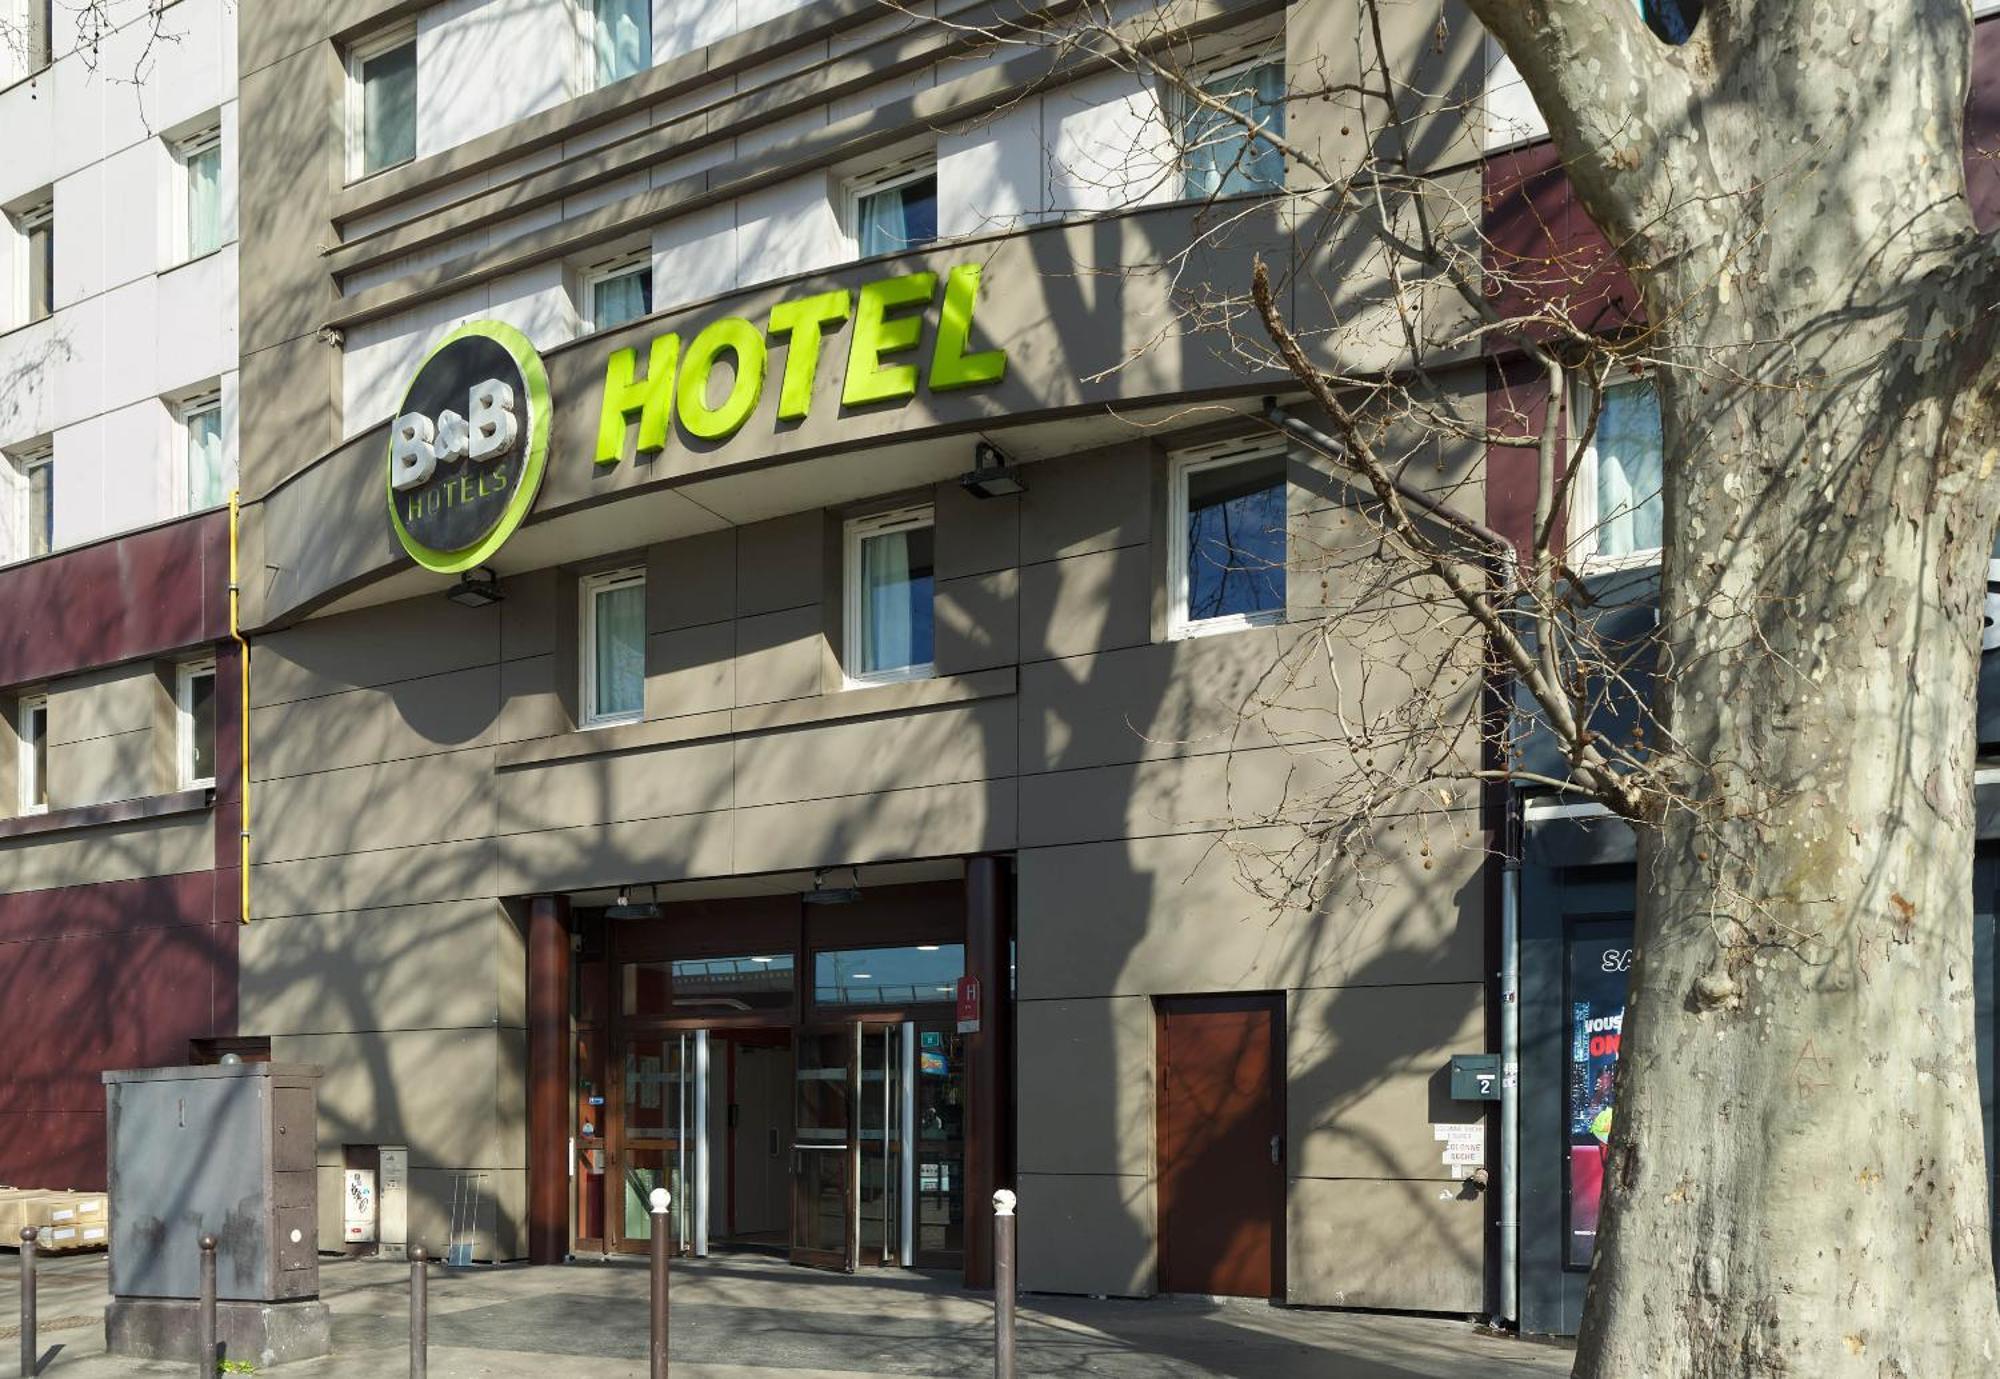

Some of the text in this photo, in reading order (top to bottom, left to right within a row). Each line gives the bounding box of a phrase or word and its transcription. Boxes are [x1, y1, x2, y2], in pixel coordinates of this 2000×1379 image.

[595, 263, 1008, 466] HOTEL
[391, 378, 518, 491] B&B
[408, 464, 508, 521] HOTELS
[1480, 1080, 1490, 1094] 2
